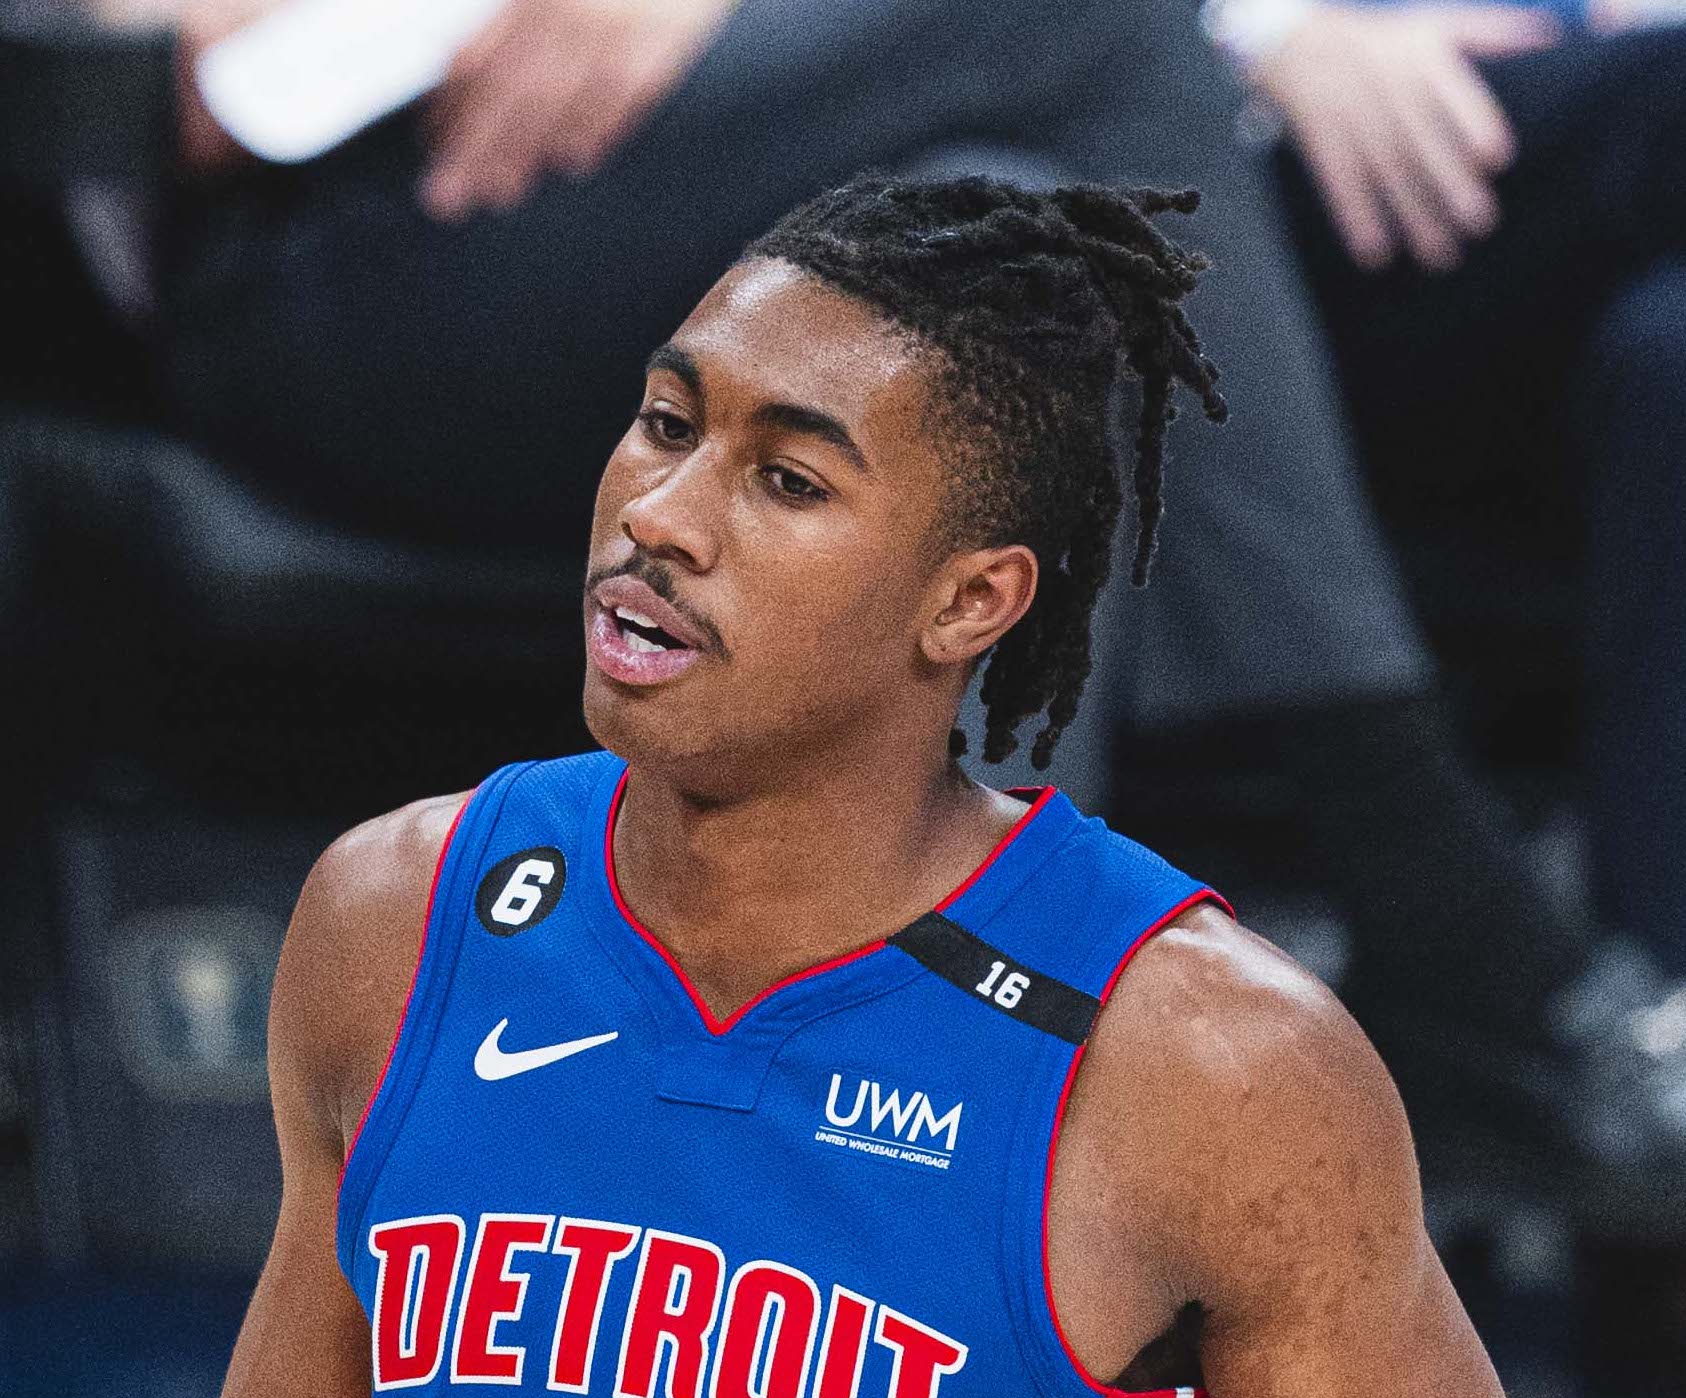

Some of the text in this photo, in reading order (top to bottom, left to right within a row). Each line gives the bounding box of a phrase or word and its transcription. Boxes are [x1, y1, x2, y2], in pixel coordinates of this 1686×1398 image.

[491, 858, 556, 927] 6
[975, 960, 1031, 1009] 16
[825, 1073, 963, 1151] UWM
[815, 1131, 950, 1169] UNITED WHOLESALE MORTGAGE
